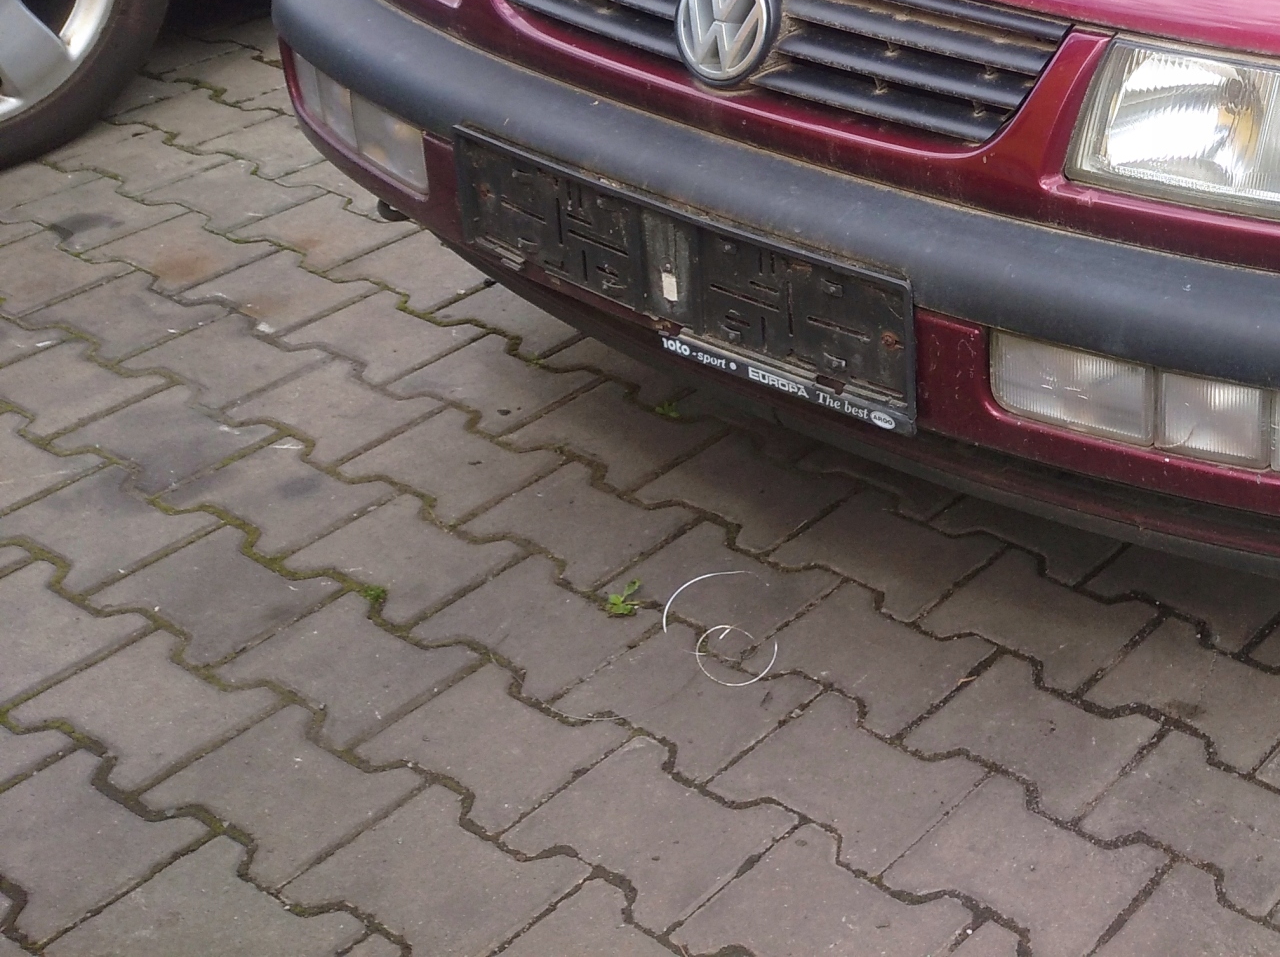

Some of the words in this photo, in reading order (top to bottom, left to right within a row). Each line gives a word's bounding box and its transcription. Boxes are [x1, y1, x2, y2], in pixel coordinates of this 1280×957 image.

[747, 366, 810, 399] EUROPA
[816, 390, 841, 409] The
[844, 401, 869, 420] best
